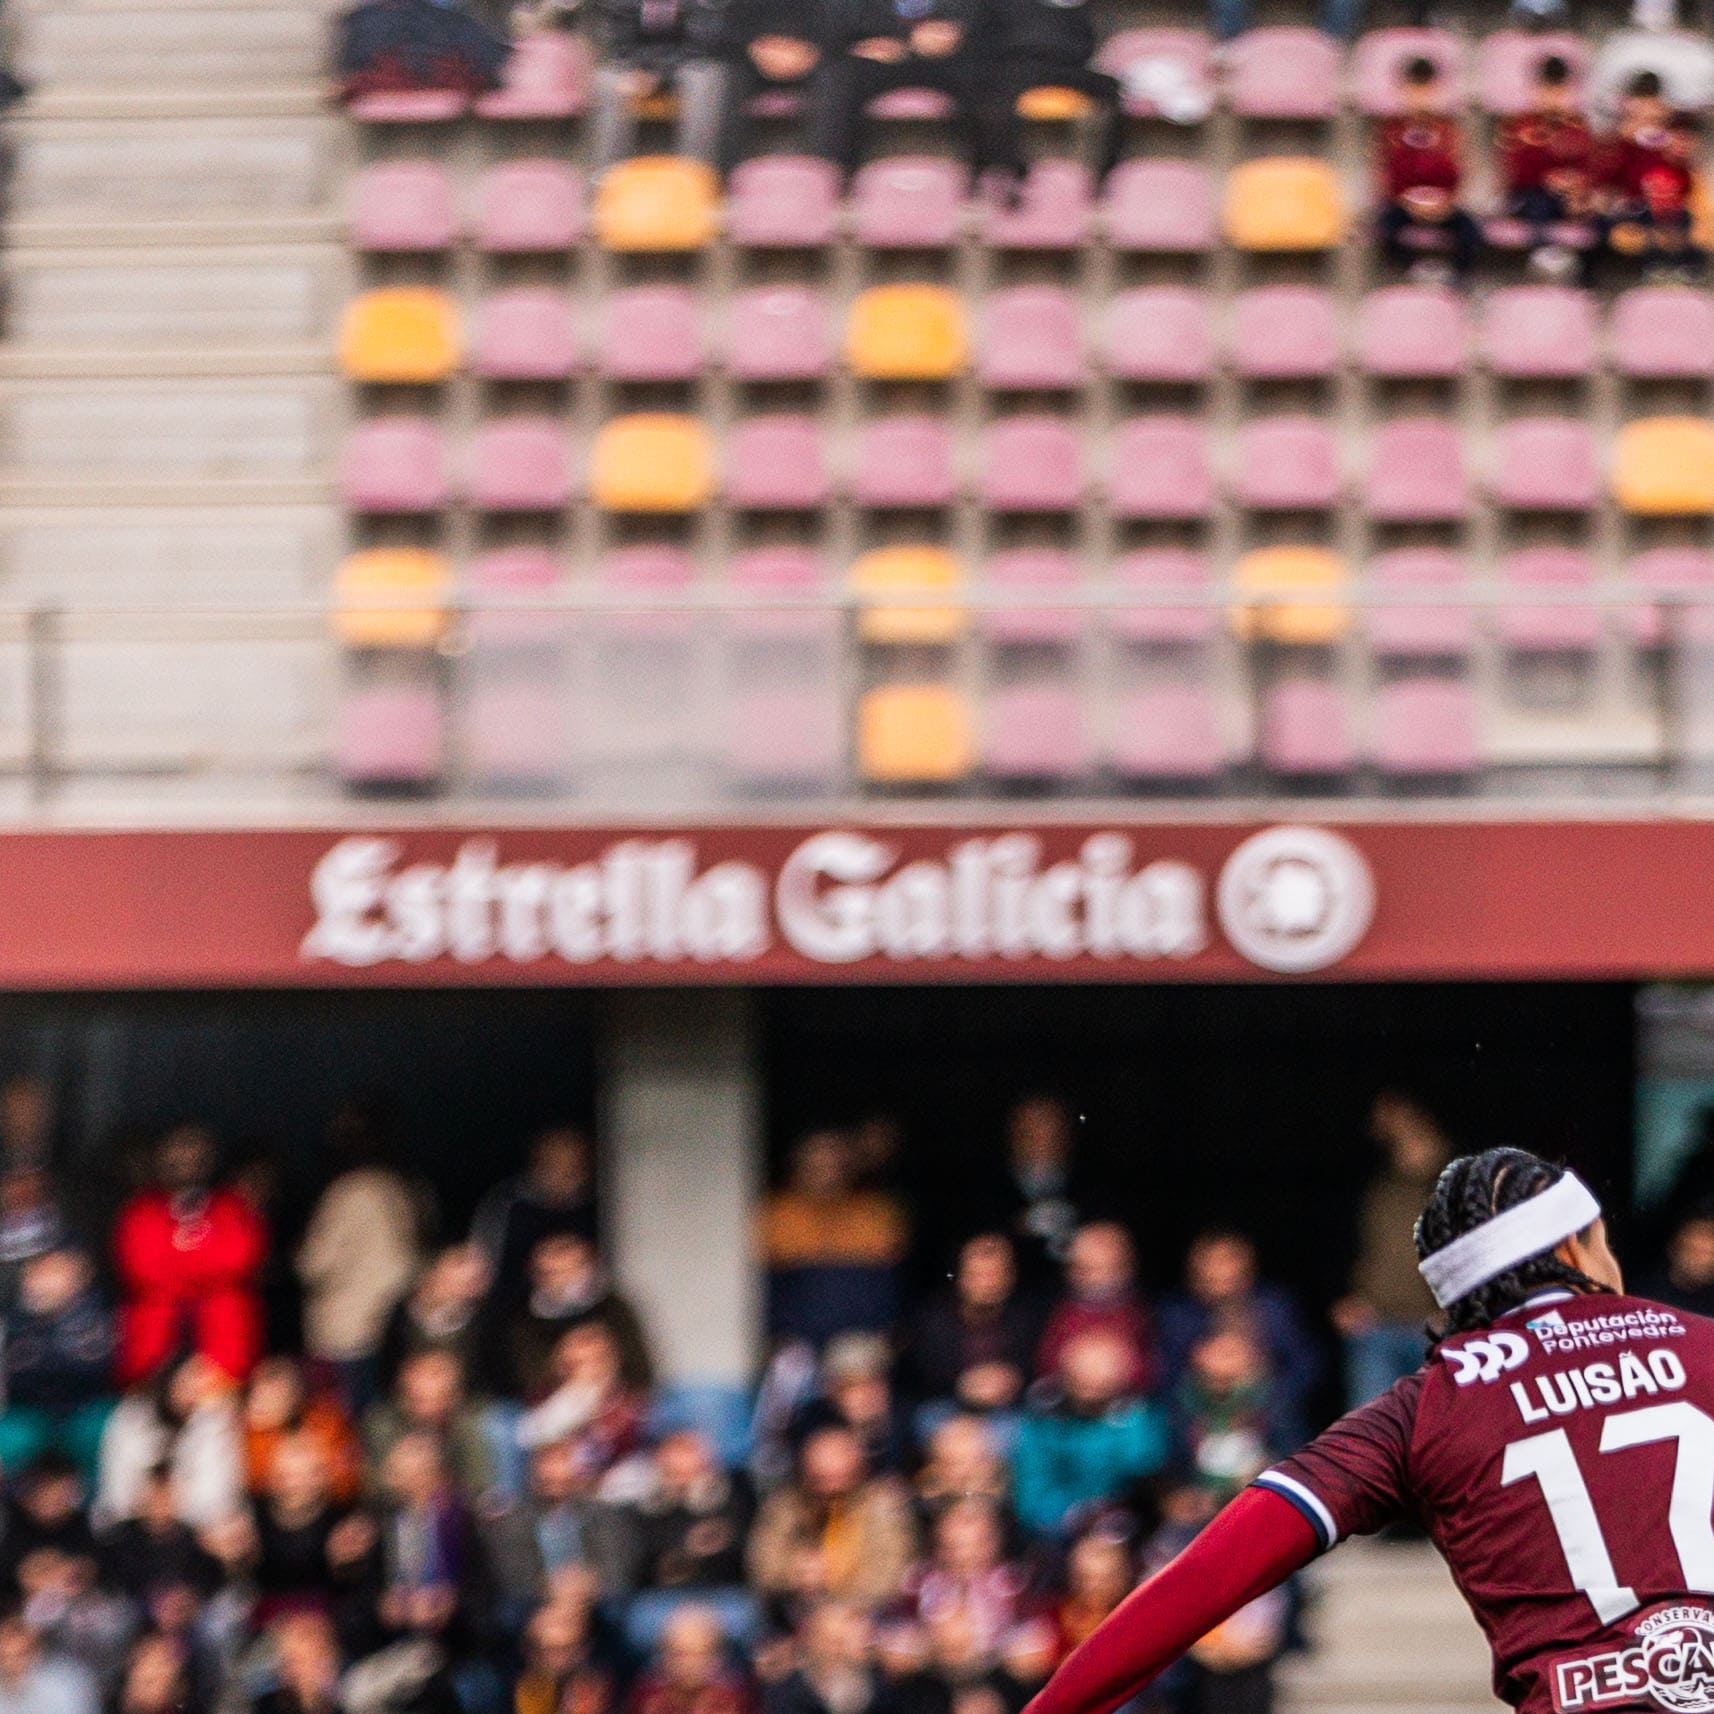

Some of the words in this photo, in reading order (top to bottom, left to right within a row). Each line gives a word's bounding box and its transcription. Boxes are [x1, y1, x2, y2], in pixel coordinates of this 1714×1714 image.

[299, 835, 767, 966] Estrella
[777, 831, 1206, 964] Galicia
[1534, 1308, 1679, 1341] Deputación
[1543, 1324, 1687, 1354] Pontevedra
[1509, 1349, 1688, 1424] LUISÃO
